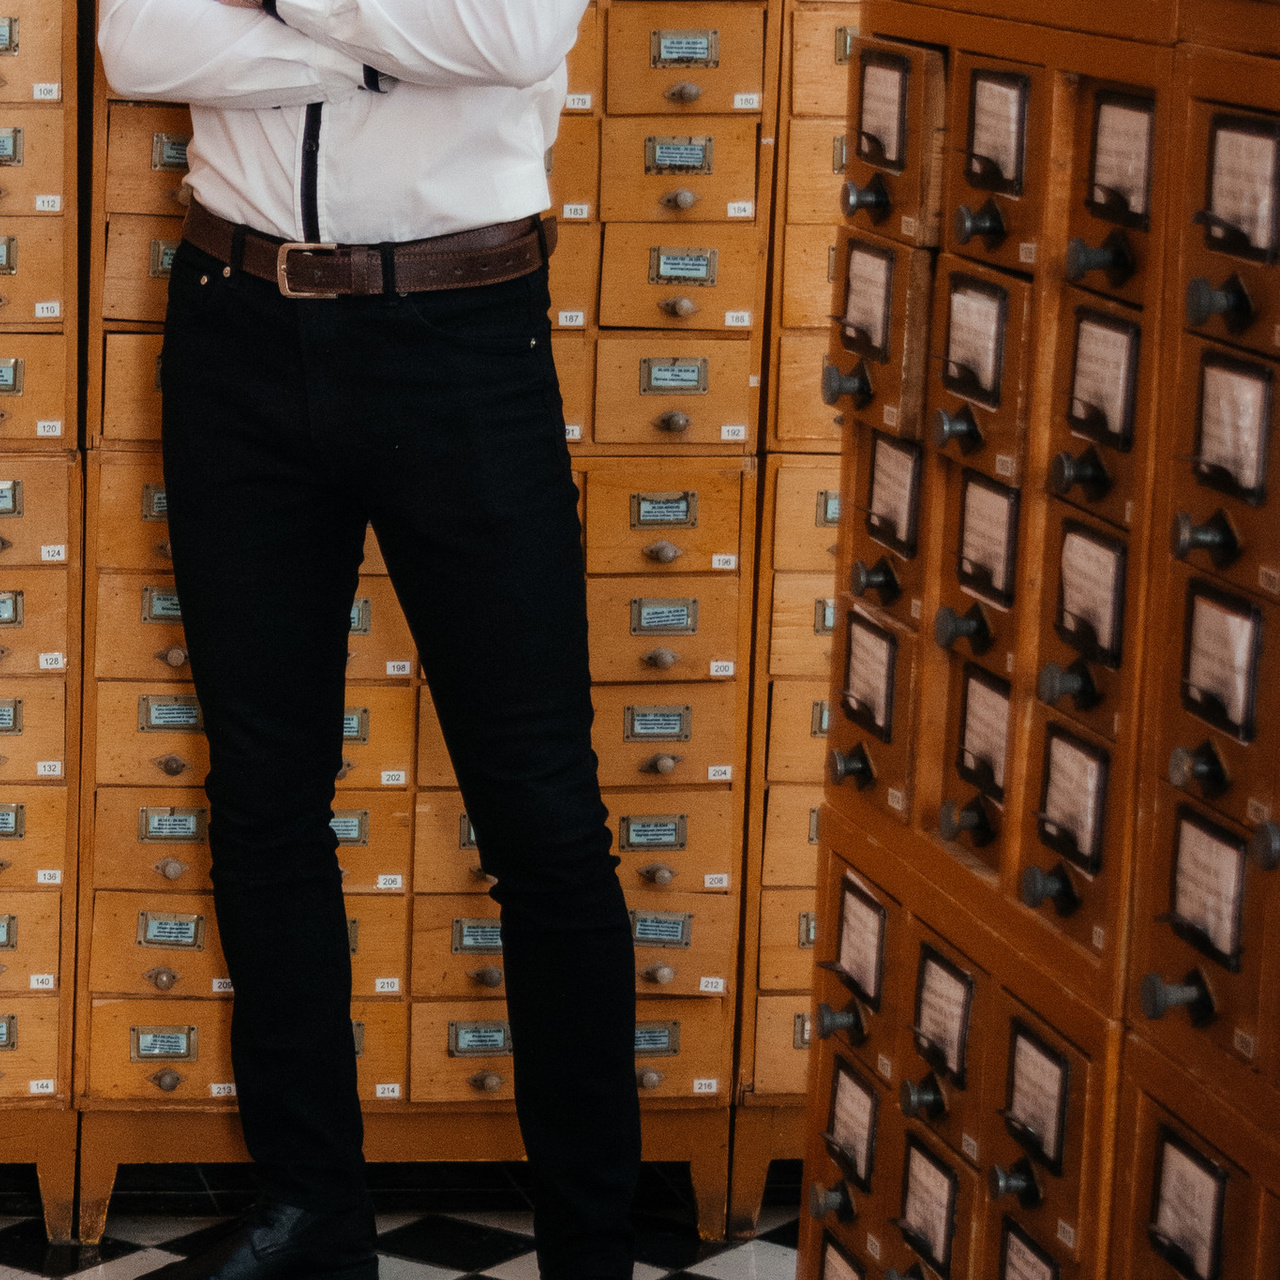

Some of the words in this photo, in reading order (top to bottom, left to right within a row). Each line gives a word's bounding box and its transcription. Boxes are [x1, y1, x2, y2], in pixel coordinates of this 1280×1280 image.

[38, 87, 54, 97] 108
[571, 97, 587, 106] 179
[739, 97, 755, 106] 180
[41, 199, 57, 209] 112
[569, 207, 584, 216] 183
[732, 206, 748, 214] 184
[564, 314, 579, 323] 187
[42, 424, 57, 433] 120
[726, 428, 741, 437] 192
[46, 549, 61, 558] 124
[717, 558, 732, 566] 196
[44, 656, 60, 666] 128
[392, 664, 407, 672] 198
[714, 665, 730, 673] 200
[42, 763, 57, 773] 132
[712, 769, 728, 777] 204
[386, 774, 401, 782] 202
[43, 872, 57, 881] 136
[709, 877, 724, 885] 208
[383, 877, 398, 886] 206
[36, 978, 50, 986] 140
[217, 981, 233, 990] 209
[380, 980, 396, 990] 210
[704, 980, 719, 990] 212
[35, 1082, 50, 1090] 144
[216, 1086, 233, 1094] 213
[697, 1082, 713, 1090] 216
[381, 1087, 396, 1095] 214
